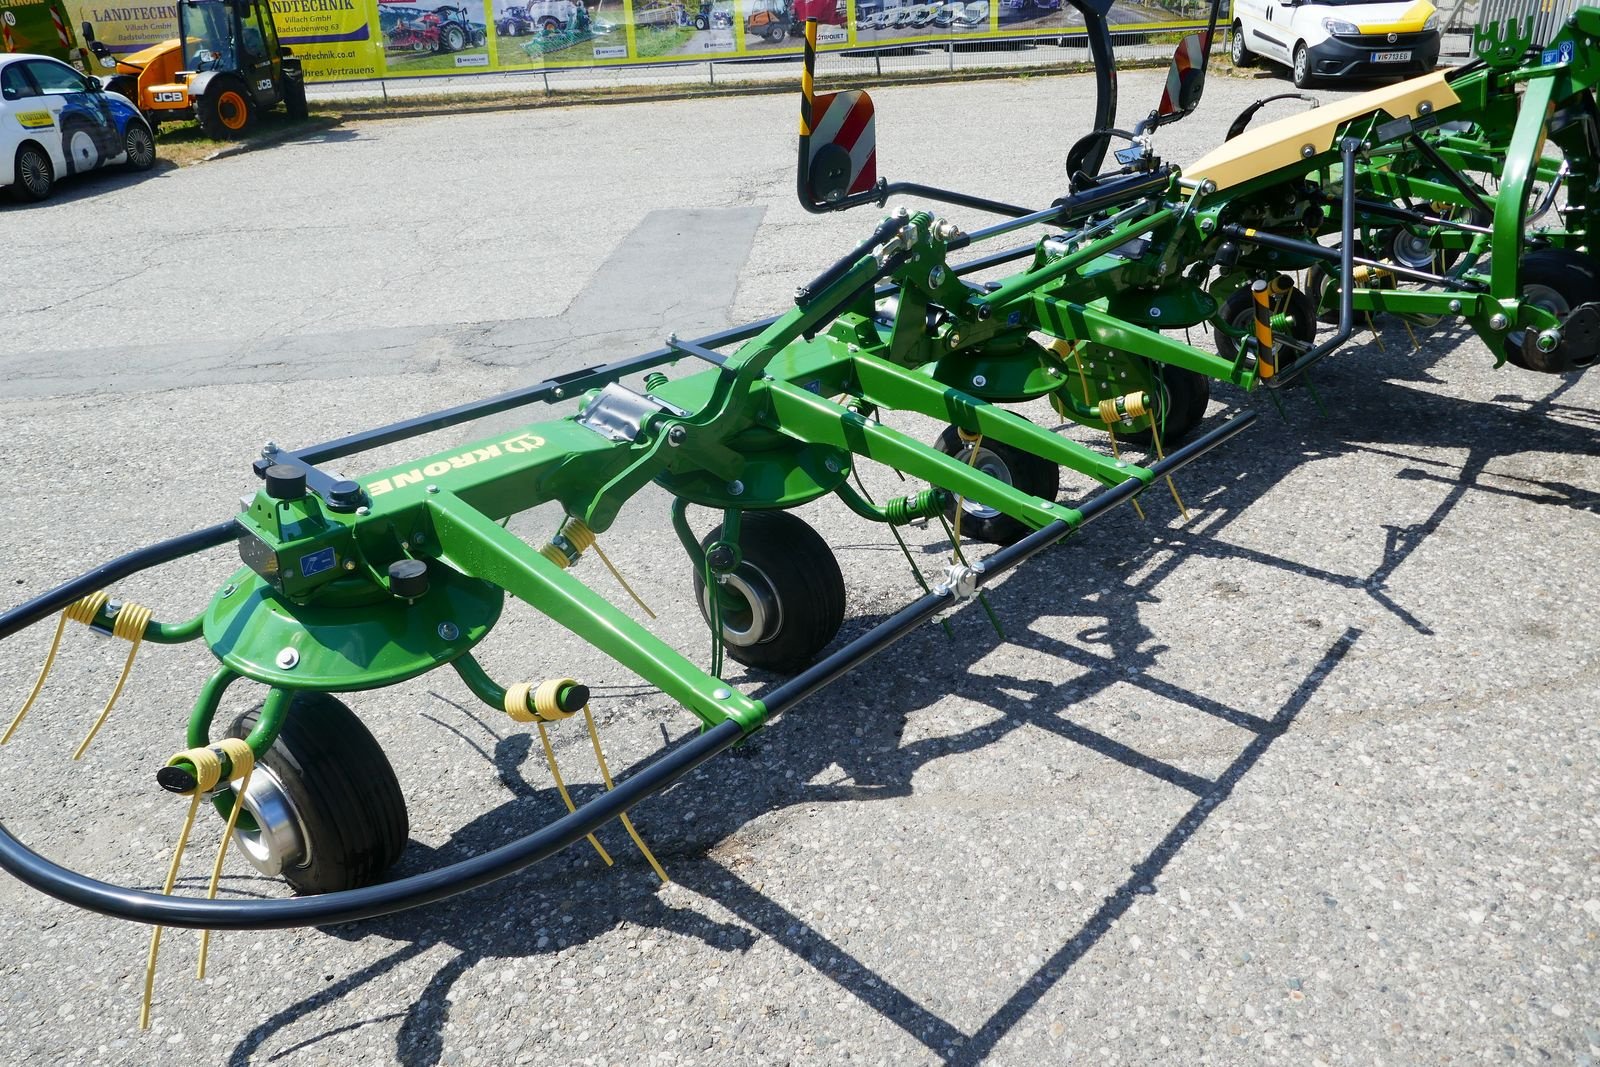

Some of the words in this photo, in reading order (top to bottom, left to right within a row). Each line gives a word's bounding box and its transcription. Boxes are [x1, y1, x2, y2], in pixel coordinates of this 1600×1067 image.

[285, 15, 308, 24] Villach
[310, 14, 332, 22] GmbH
[277, 25, 329, 33] Badstubenweg
[326, 66, 375, 76] Vertrauens
[257, 79, 272, 90] JCB
[154, 92, 184, 102] JCB
[366, 444, 503, 496] KRONE
